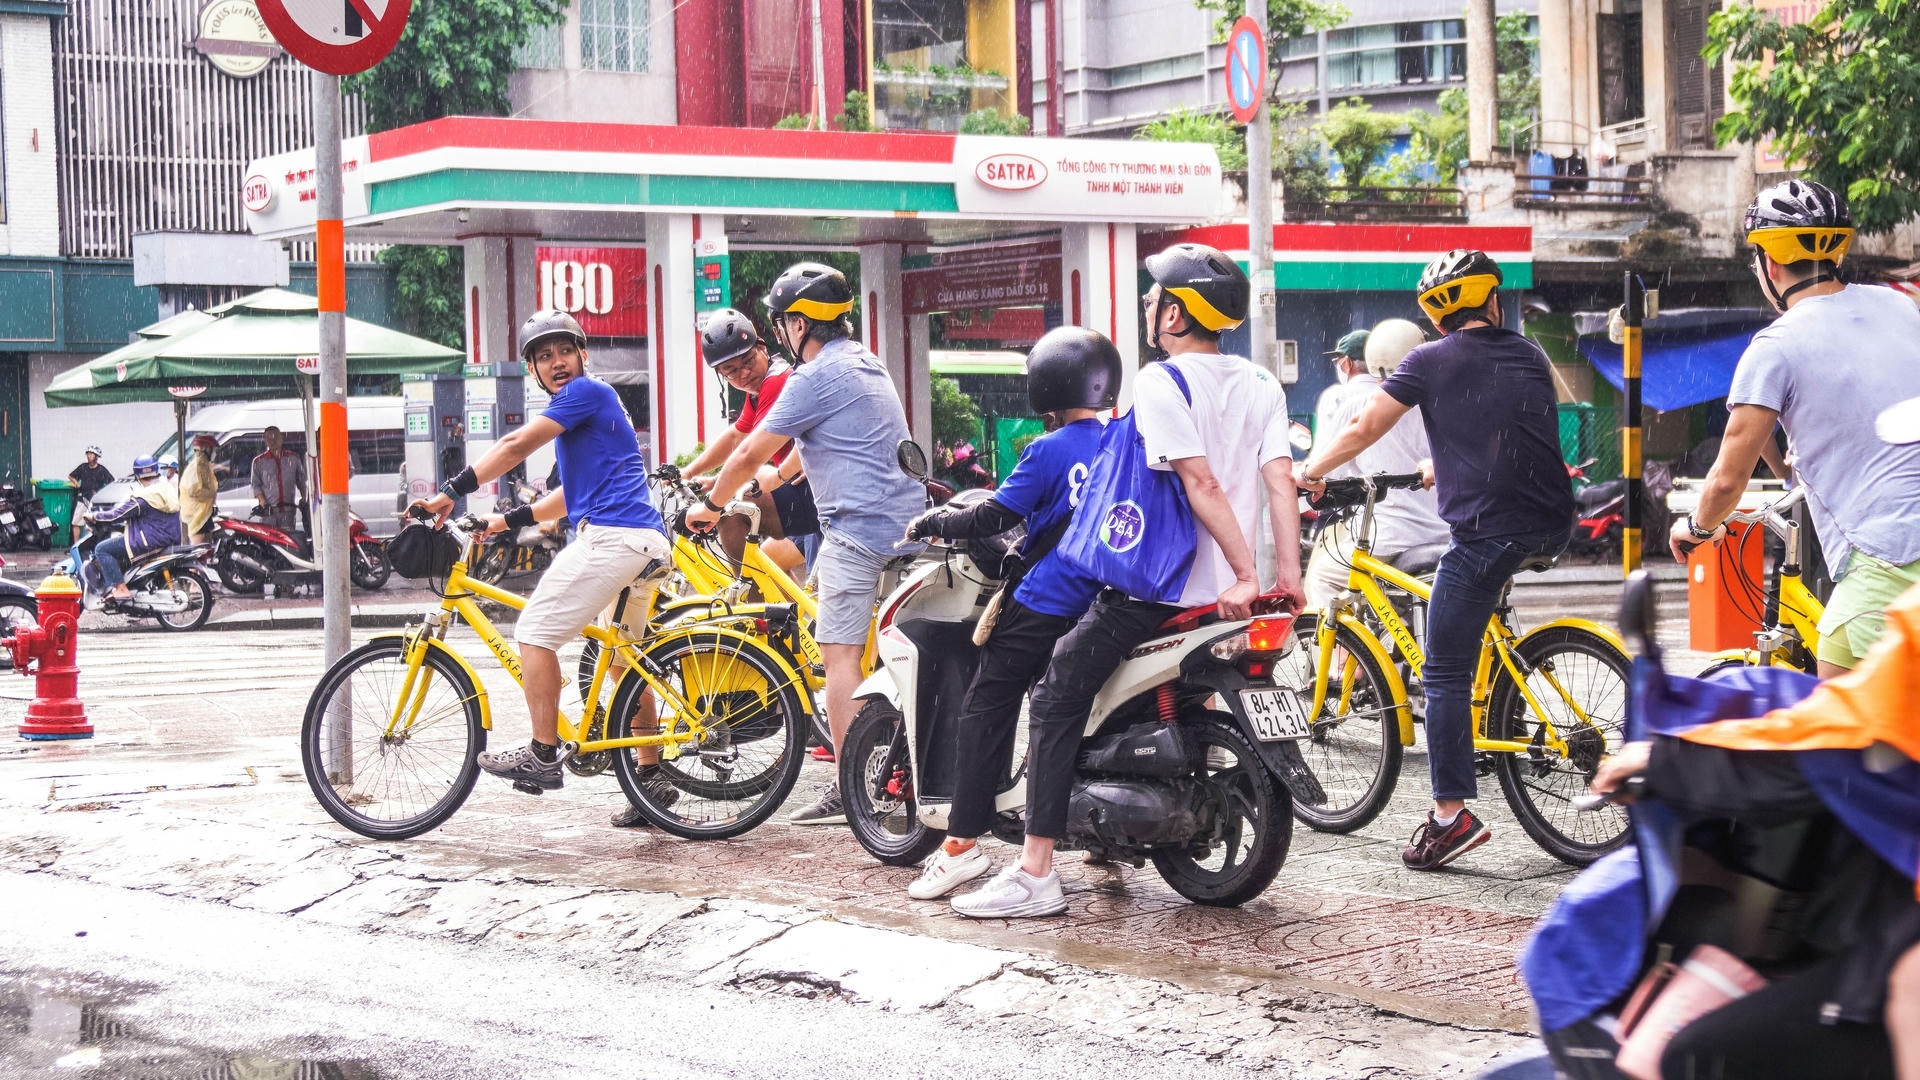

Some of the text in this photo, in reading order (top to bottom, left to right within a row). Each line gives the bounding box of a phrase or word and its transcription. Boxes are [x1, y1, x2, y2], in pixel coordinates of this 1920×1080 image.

[211, 7, 230, 35] TOUS
[244, 7, 269, 40] JOURS
[987, 162, 1036, 181] SATRA
[1083, 160, 1107, 174] CÔNG
[1109, 162, 1122, 174] TY
[246, 183, 268, 203] SATRA
[1086, 180, 1111, 193] TNHH
[540, 260, 614, 315] 180
[297, 357, 318, 369] SAT
[1377, 604, 1422, 667] JACKFRUI
[1250, 692, 1293, 714] 84-H1
[1255, 714, 1308, 737] 424.34
